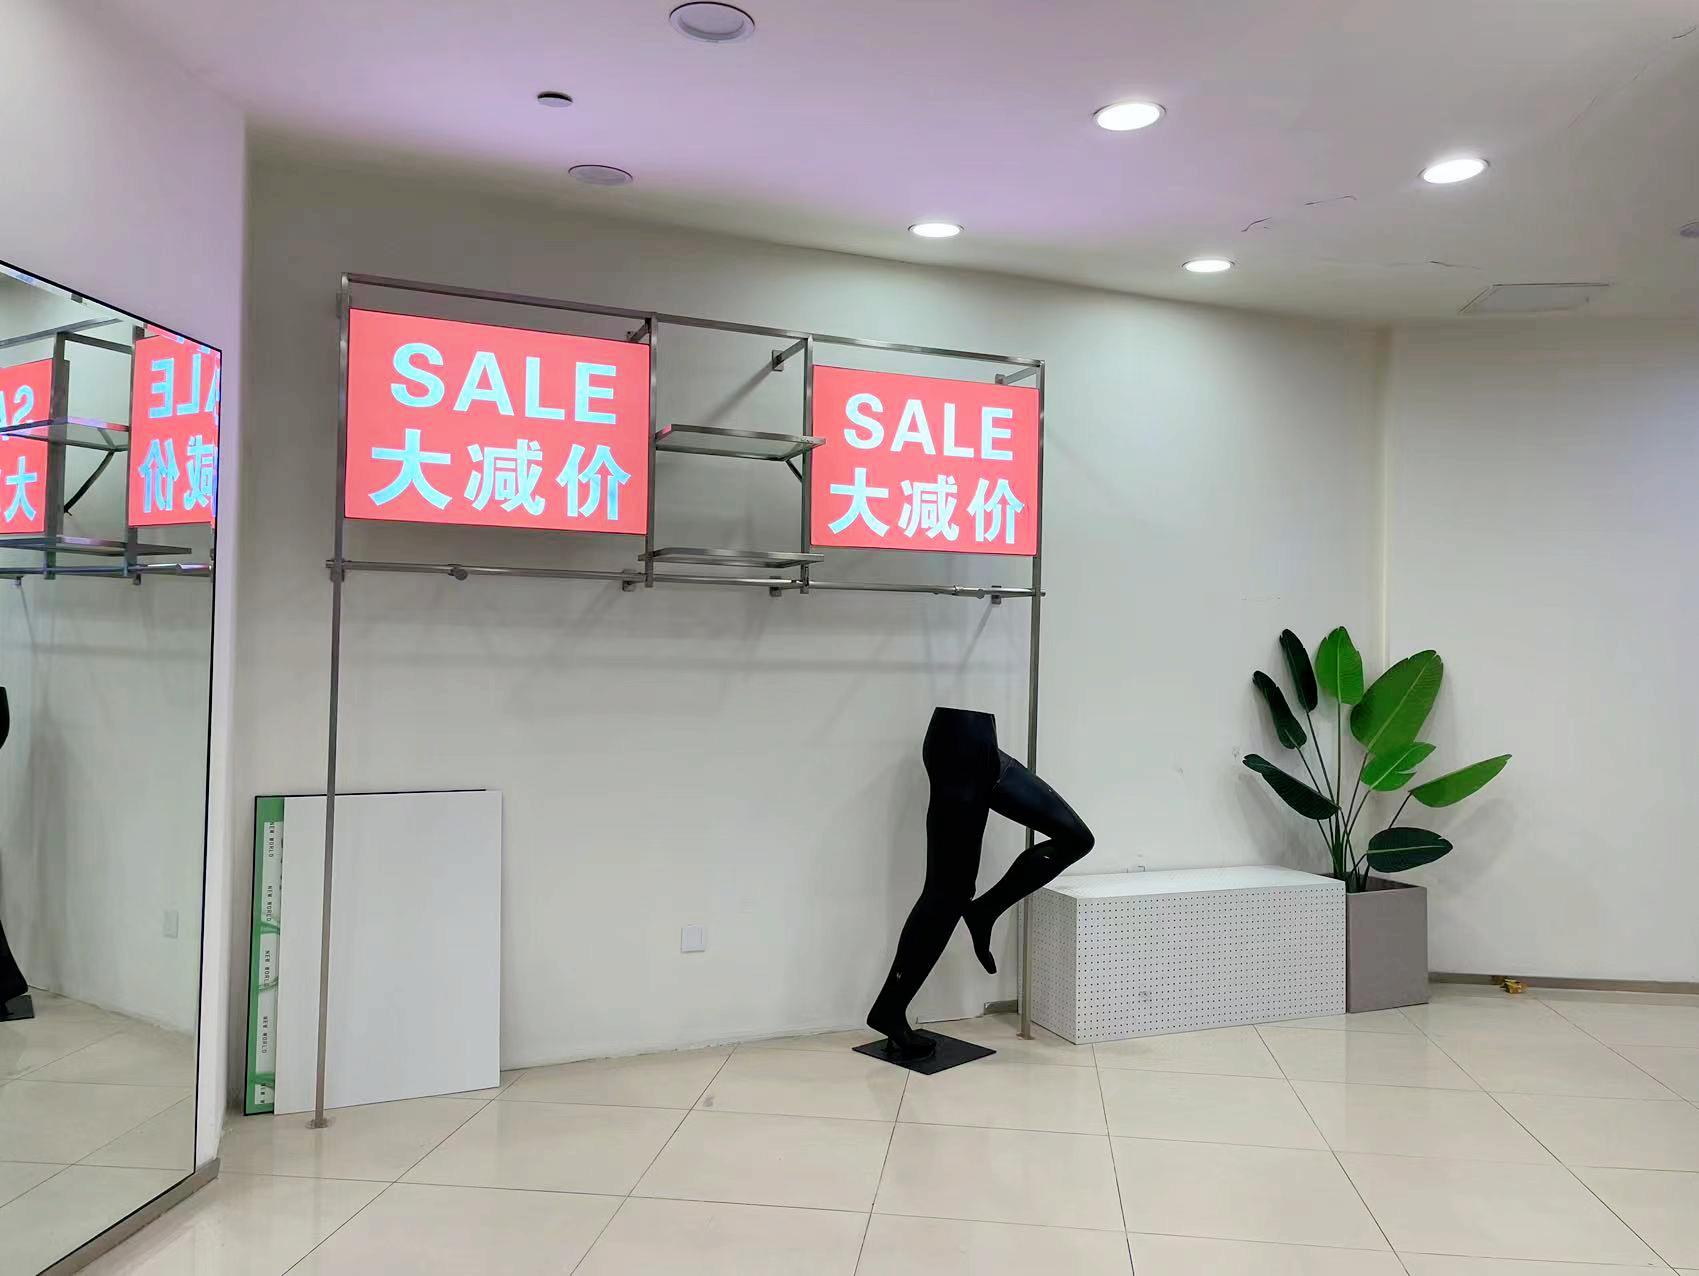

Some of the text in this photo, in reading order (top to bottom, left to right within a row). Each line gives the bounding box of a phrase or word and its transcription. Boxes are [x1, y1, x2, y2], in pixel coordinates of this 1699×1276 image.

[390, 342, 617, 425] SALE
[843, 392, 1014, 461] SALE
[368, 428, 631, 521] 大减价
[828, 467, 1025, 545] 大减价
